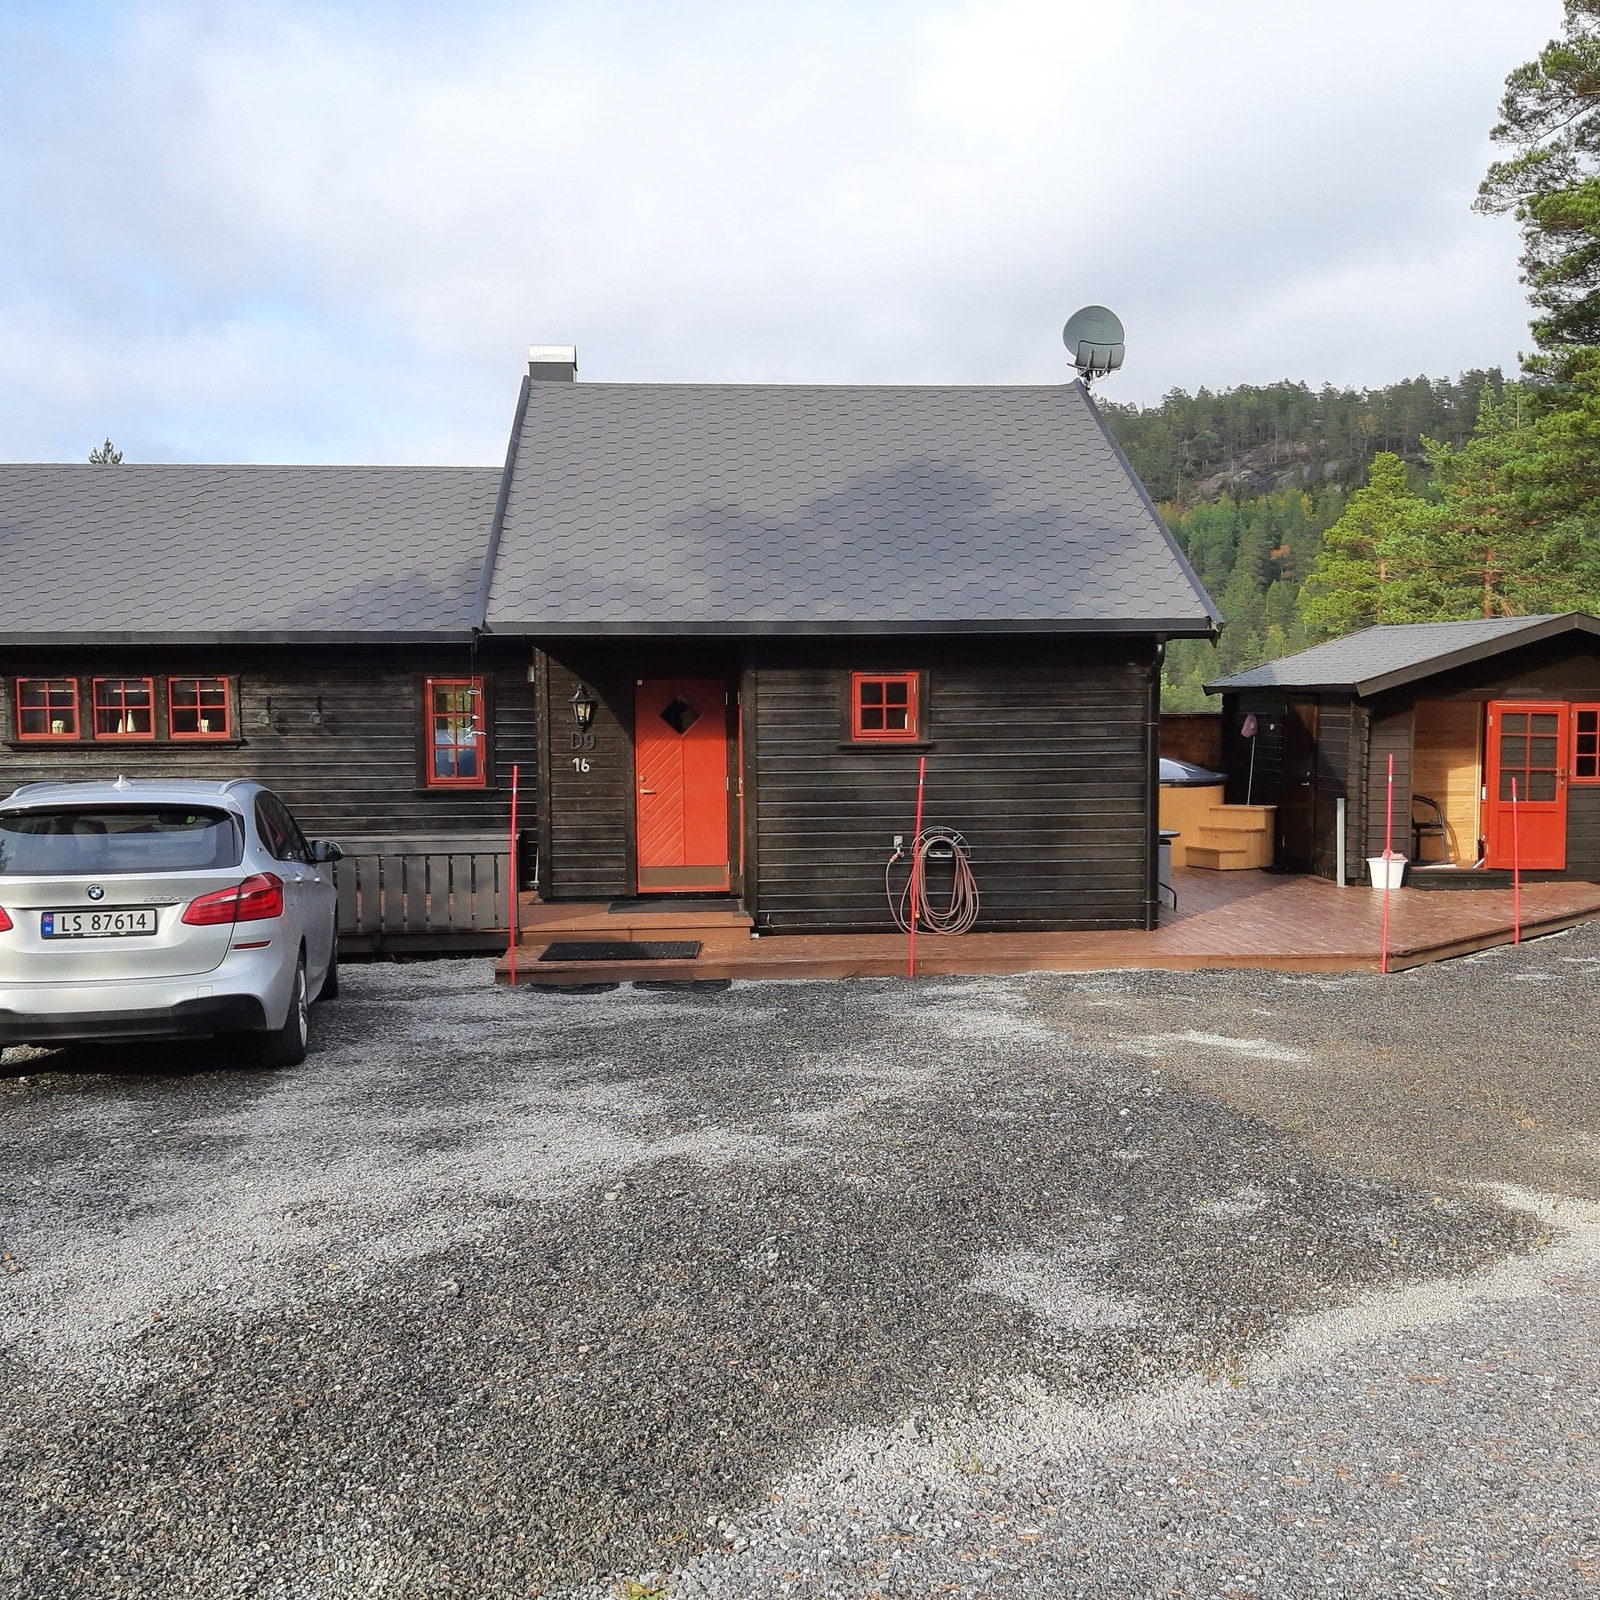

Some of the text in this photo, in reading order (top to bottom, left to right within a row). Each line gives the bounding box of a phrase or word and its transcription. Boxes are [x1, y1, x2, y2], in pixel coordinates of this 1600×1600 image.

[571, 731, 595, 750] D9
[572, 757, 590, 773] 16
[61, 913, 147, 932] LS 87614
